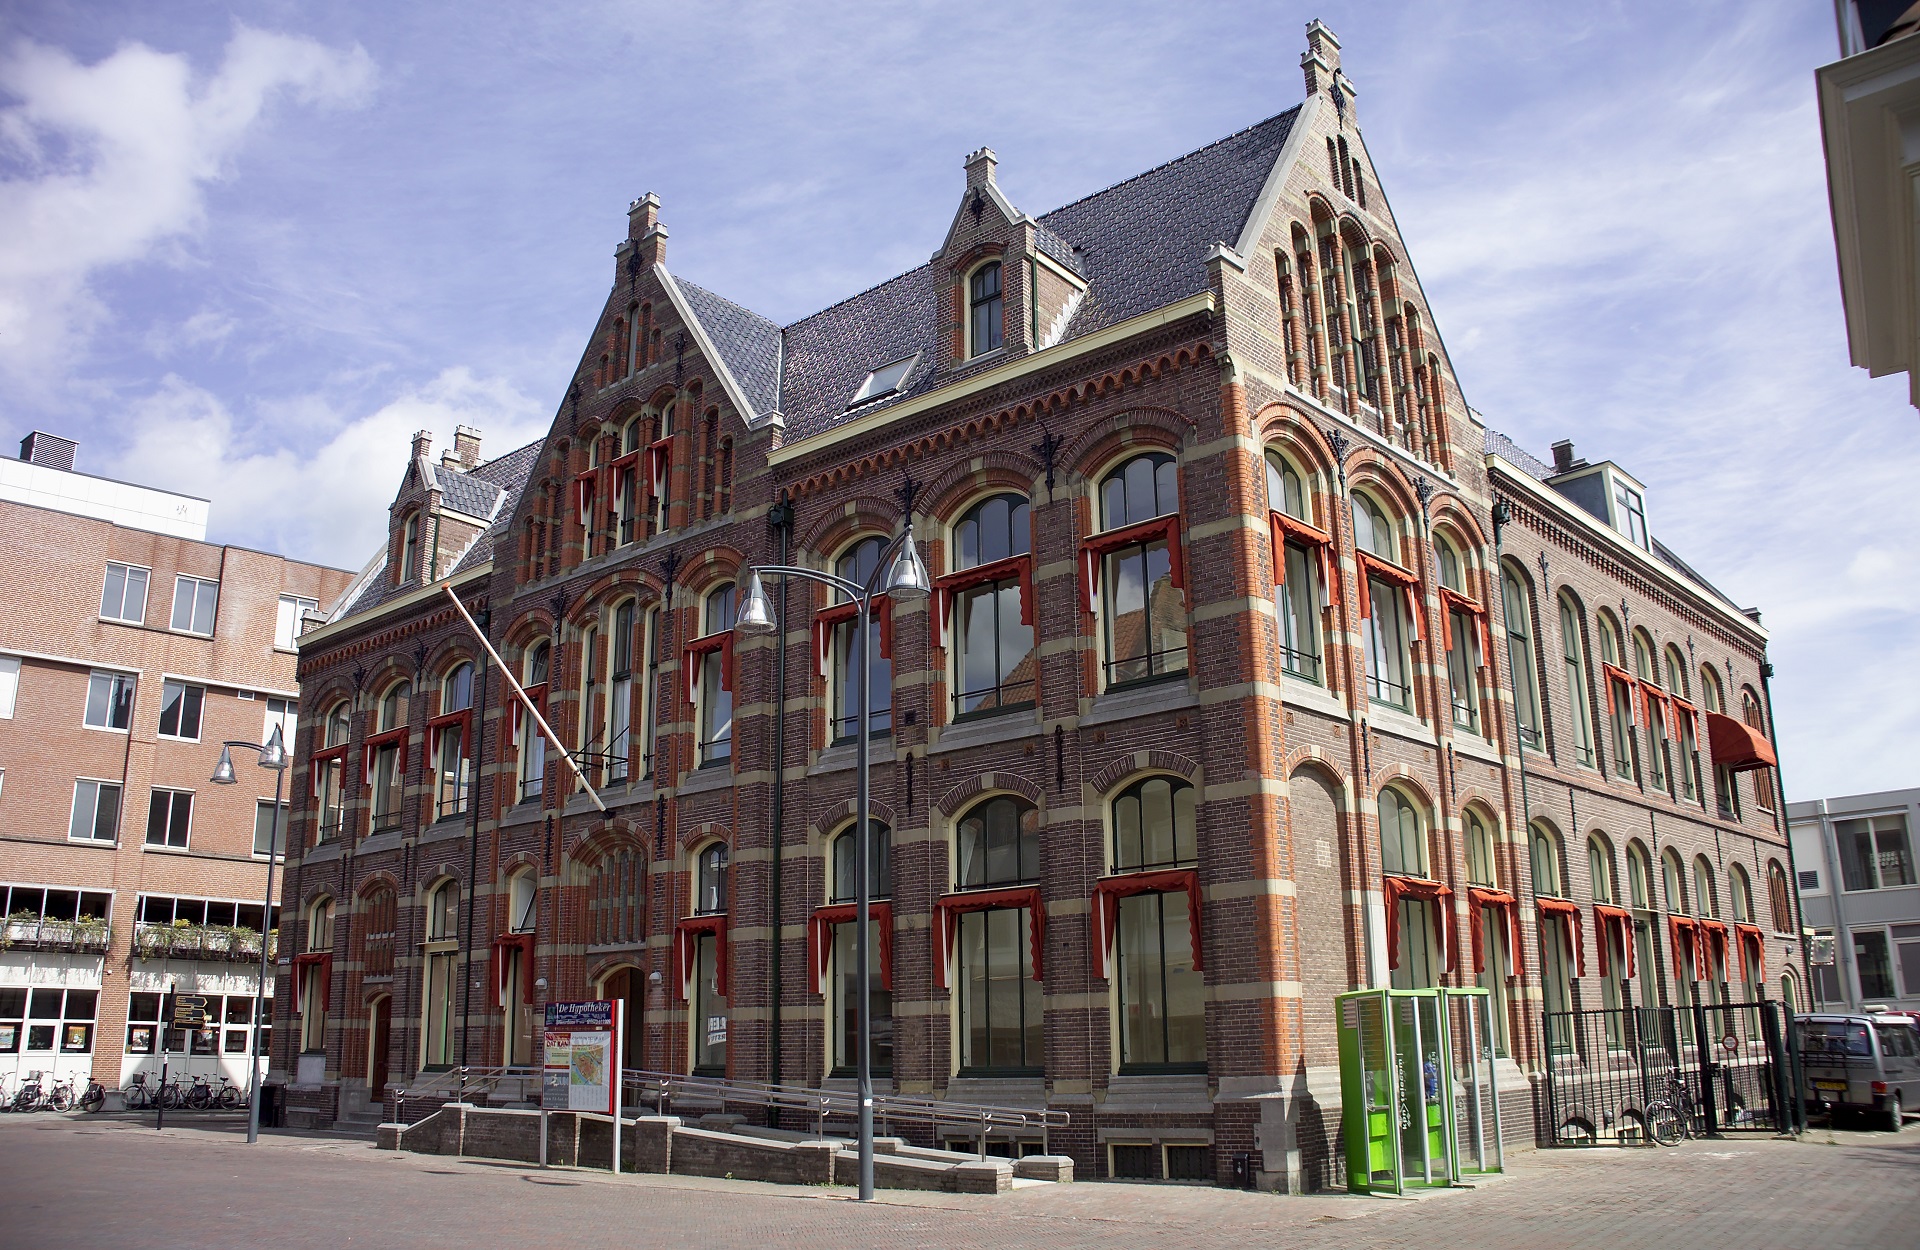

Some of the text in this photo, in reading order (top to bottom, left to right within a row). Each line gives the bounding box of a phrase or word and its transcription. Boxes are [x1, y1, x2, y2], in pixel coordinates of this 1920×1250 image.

[559, 1002, 611, 1014] De Hypotheker
[1398, 1059, 1406, 1102] telecom
